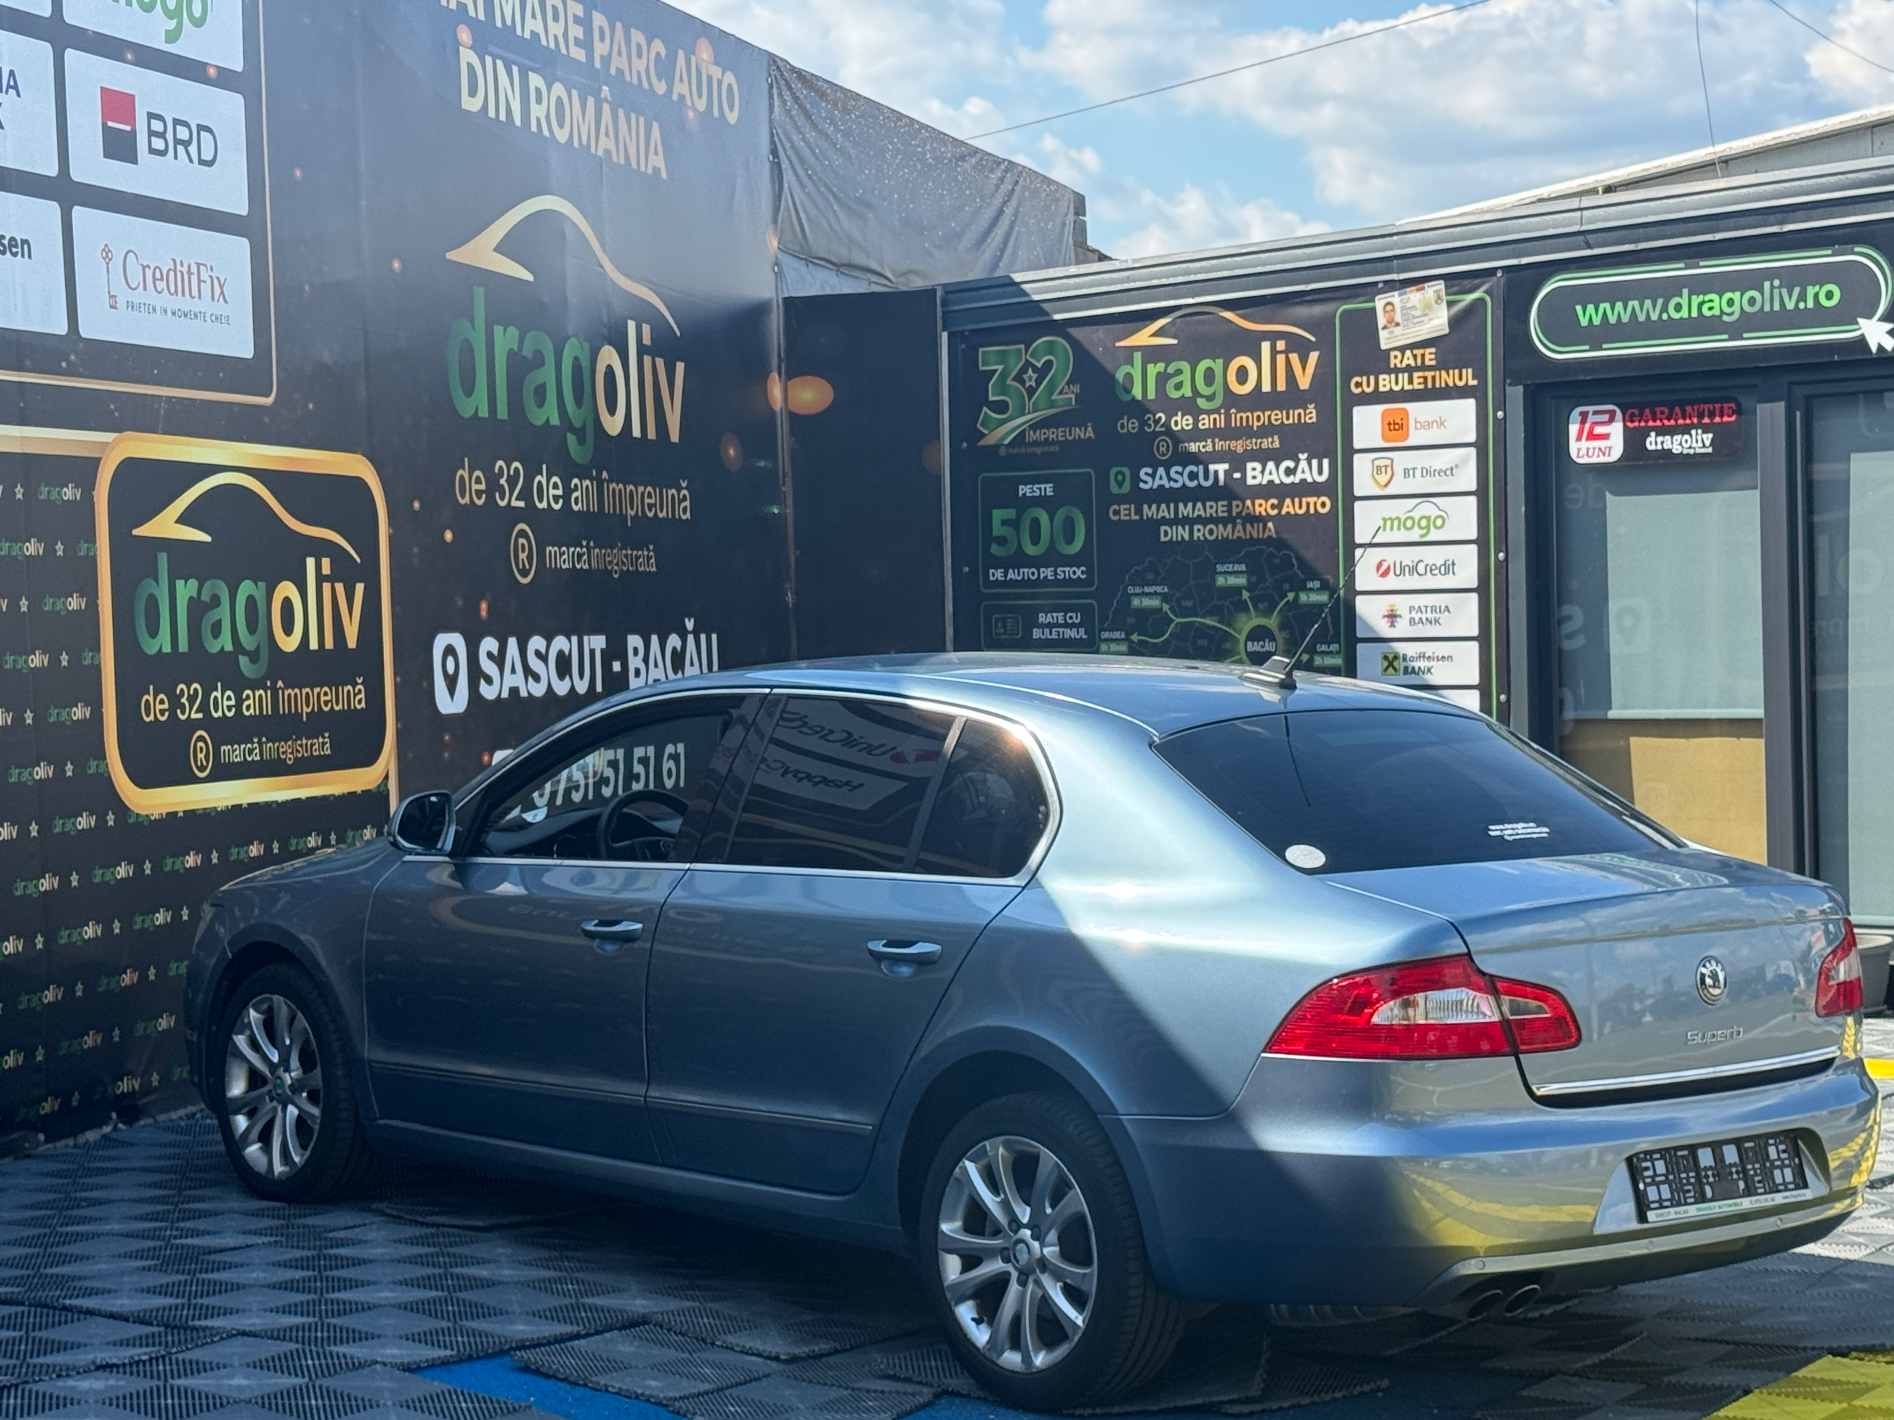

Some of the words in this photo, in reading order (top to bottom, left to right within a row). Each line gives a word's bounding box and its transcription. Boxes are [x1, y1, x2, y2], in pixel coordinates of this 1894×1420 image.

[493, 0, 586, 63] MARE
[592, 10, 667, 95] PARC
[672, 48, 740, 125] AUTO
[459, 46, 522, 127] DIN
[528, 70, 667, 180] ROMÂNIA
[146, 111, 218, 168] BRD
[123, 249, 229, 305] CreditFix
[126, 300, 157, 314] PRIETEN
[171, 307, 207, 322] MOMENTE
[1575, 279, 1841, 327] www.dragoliv.ro
[1389, 348, 1436, 368] RATE
[447, 286, 685, 464] dragoliv
[1114, 340, 1320, 409] dragoliv
[1350, 375, 1375, 393] CU
[1378, 368, 1478, 392] BULETINUL
[1063, 384, 1080, 394] ANI
[1117, 415, 1139, 433] de
[1144, 412, 1166, 432] 32
[1170, 411, 1193, 431] de
[1198, 409, 1225, 429] ani
[1230, 403, 1317, 431] împreună
[1386, 417, 1404, 432] tbi
[1414, 416, 1447, 430] bank
[1575, 409, 1617, 442] 12
[1625, 403, 1738, 428] GARANTIE
[1178, 439, 1213, 453] marcă
[1215, 435, 1280, 453] înregistrată
[1576, 446, 1612, 459] LUNI
[1645, 429, 1713, 455] dragoliv
[1138, 463, 1230, 489] SASCUT
[1246, 453, 1330, 485] BACĂU
[1375, 465, 1389, 476] BT
[1403, 467, 1417, 479] BT
[455, 457, 486, 506] de
[494, 460, 525, 508] 32
[533, 464, 563, 510] de
[570, 470, 598, 513] ani
[603, 472, 692, 527] împreună
[1018, 483, 1055, 497] PESTE
[1109, 505, 1140, 521] CEL
[1143, 503, 1175, 519] MAI
[1178, 501, 1228, 517] MARE
[1232, 498, 1278, 516] PARC
[1281, 496, 1331, 515] AUTO
[989, 505, 1086, 557] 500
[1160, 525, 1190, 542] DIN
[1193, 519, 1277, 540] ROMÂNIA
[1381, 514, 1446, 538] mogo
[546, 541, 589, 570] marcă
[590, 541, 657, 578] înregistrată
[1393, 559, 1456, 577] UniCredit
[989, 568, 1005, 581] DE
[1007, 568, 1038, 580] AUTO
[1040, 567, 1055, 580] PE
[1057, 567, 1087, 579] STOC
[133, 552, 365, 678] dragoliv
[1038, 612, 1064, 624] RATE
[1066, 612, 1081, 623] CU
[1408, 605, 1451, 615] PATRIA
[1408, 616, 1442, 626] BANK
[1032, 627, 1088, 639] BULETINUL
[478, 635, 606, 700] SASCUT
[627, 618, 719, 688] BACĂU
[1402, 653, 1453, 663] Raiffeisen
[1402, 666, 1434, 676] BANK
[141, 685, 170, 722] de
[176, 683, 203, 720] 32
[209, 682, 235, 717] de
[242, 681, 272, 715] ani
[278, 676, 366, 721] împreună
[220, 738, 260, 764] marcă
[262, 732, 331, 764] înregistrată
[601, 748, 624, 798] 51
[632, 746, 655, 791] 51
[663, 743, 685, 790] 61
[1687, 1025, 1744, 1046] Superb
